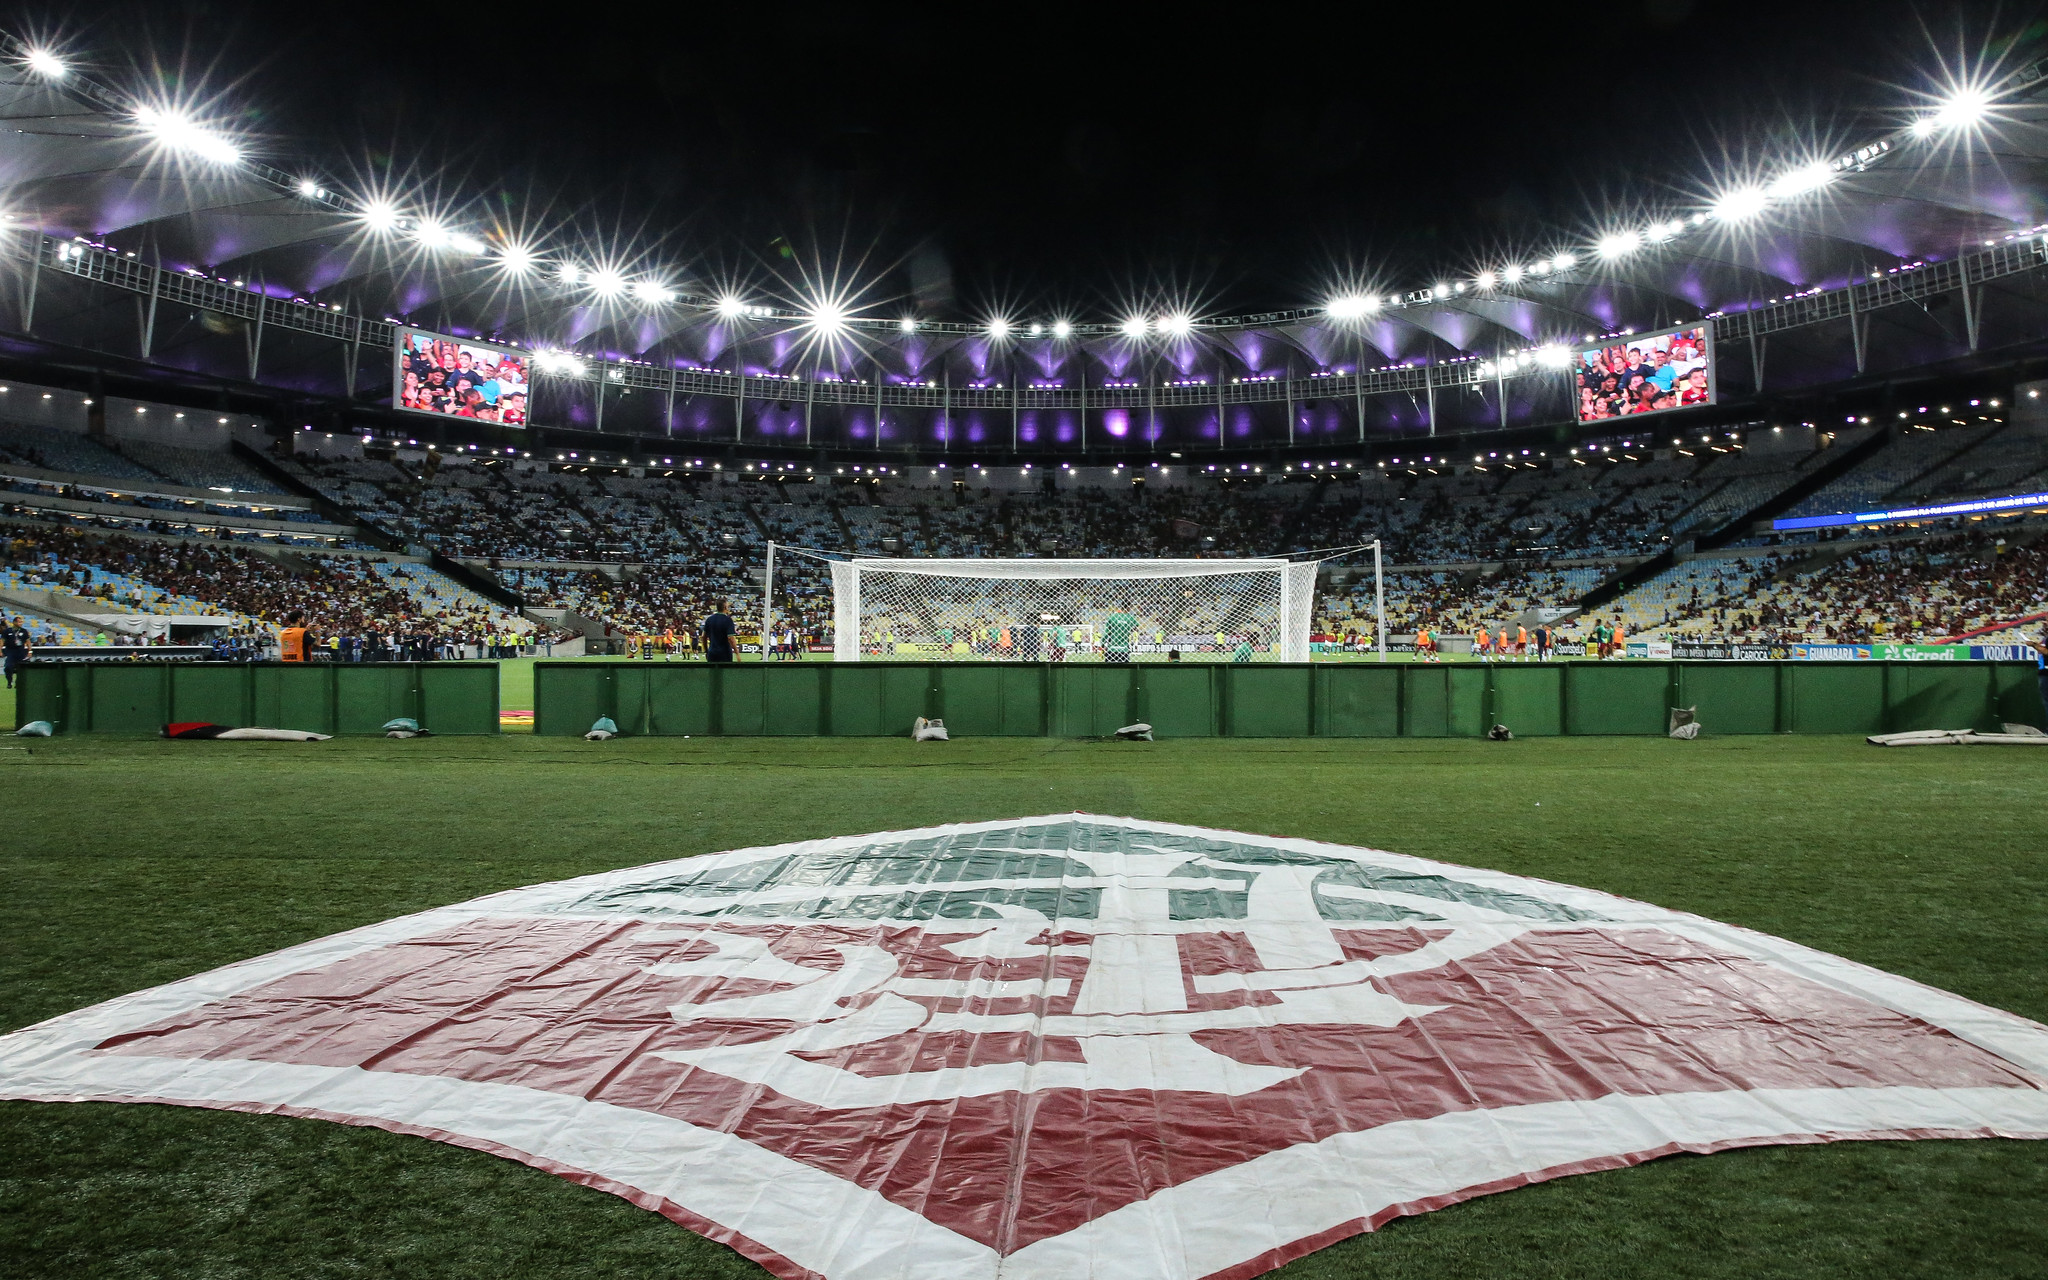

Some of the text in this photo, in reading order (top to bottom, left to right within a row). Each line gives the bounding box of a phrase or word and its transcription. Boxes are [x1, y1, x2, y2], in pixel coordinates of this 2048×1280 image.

[1740, 650, 1768, 660] CARIOCA
[1809, 647, 1853, 660] GUANABARA
[1903, 647, 1955, 660] Sicredi
[1982, 645, 2013, 660] VODKA
